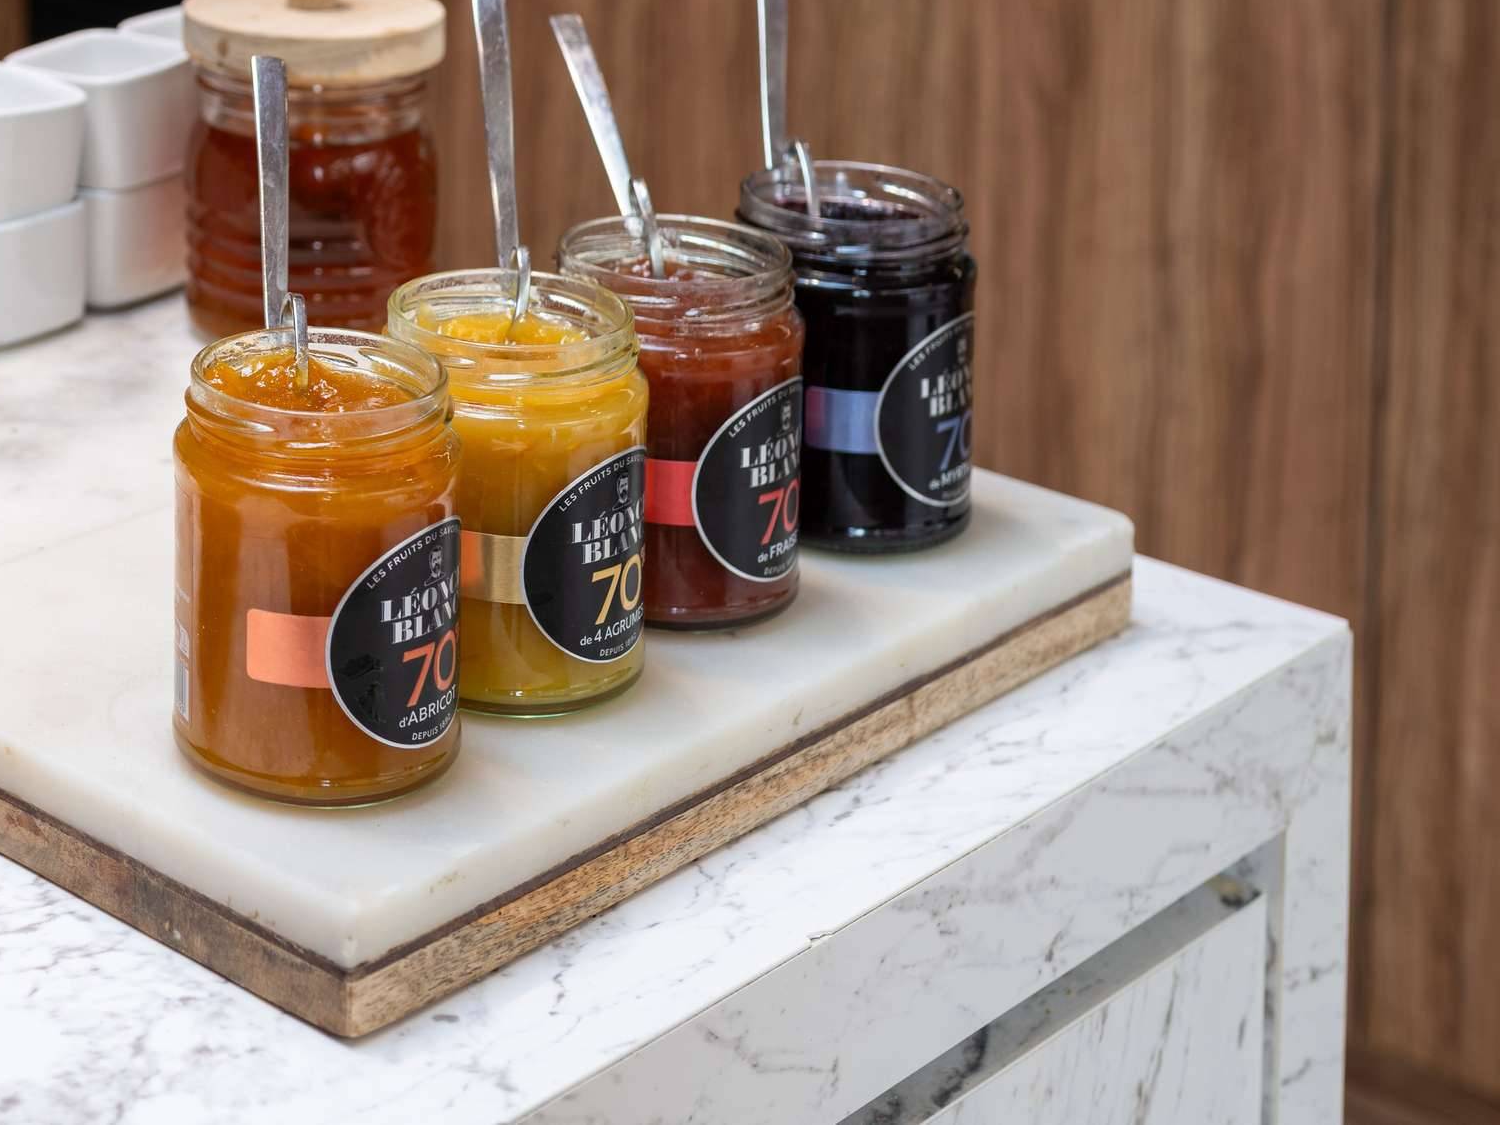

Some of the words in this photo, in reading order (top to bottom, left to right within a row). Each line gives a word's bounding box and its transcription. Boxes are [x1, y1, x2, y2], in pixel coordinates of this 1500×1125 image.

[728, 419, 746, 437] LES
[746, 396, 777, 422] FRUITS
[559, 493, 577, 512] LES
[578, 467, 612, 495] FRUITS
[613, 460, 625, 472] DU
[572, 494, 645, 544] LÉONC
[367, 569, 386, 589] LES
[387, 540, 423, 571] FRUITS
[425, 532, 438, 545] DU
[758, 554, 768, 563] de
[380, 566, 460, 623] LÉONC
[580, 636, 592, 646] de
[594, 629, 602, 642] 4
[604, 603, 644, 640] AGRUMES
[600, 643, 624, 657] DEPUIS
[399, 684, 457, 728] d'ABRICOT
[412, 726, 438, 741] DEPUIS
